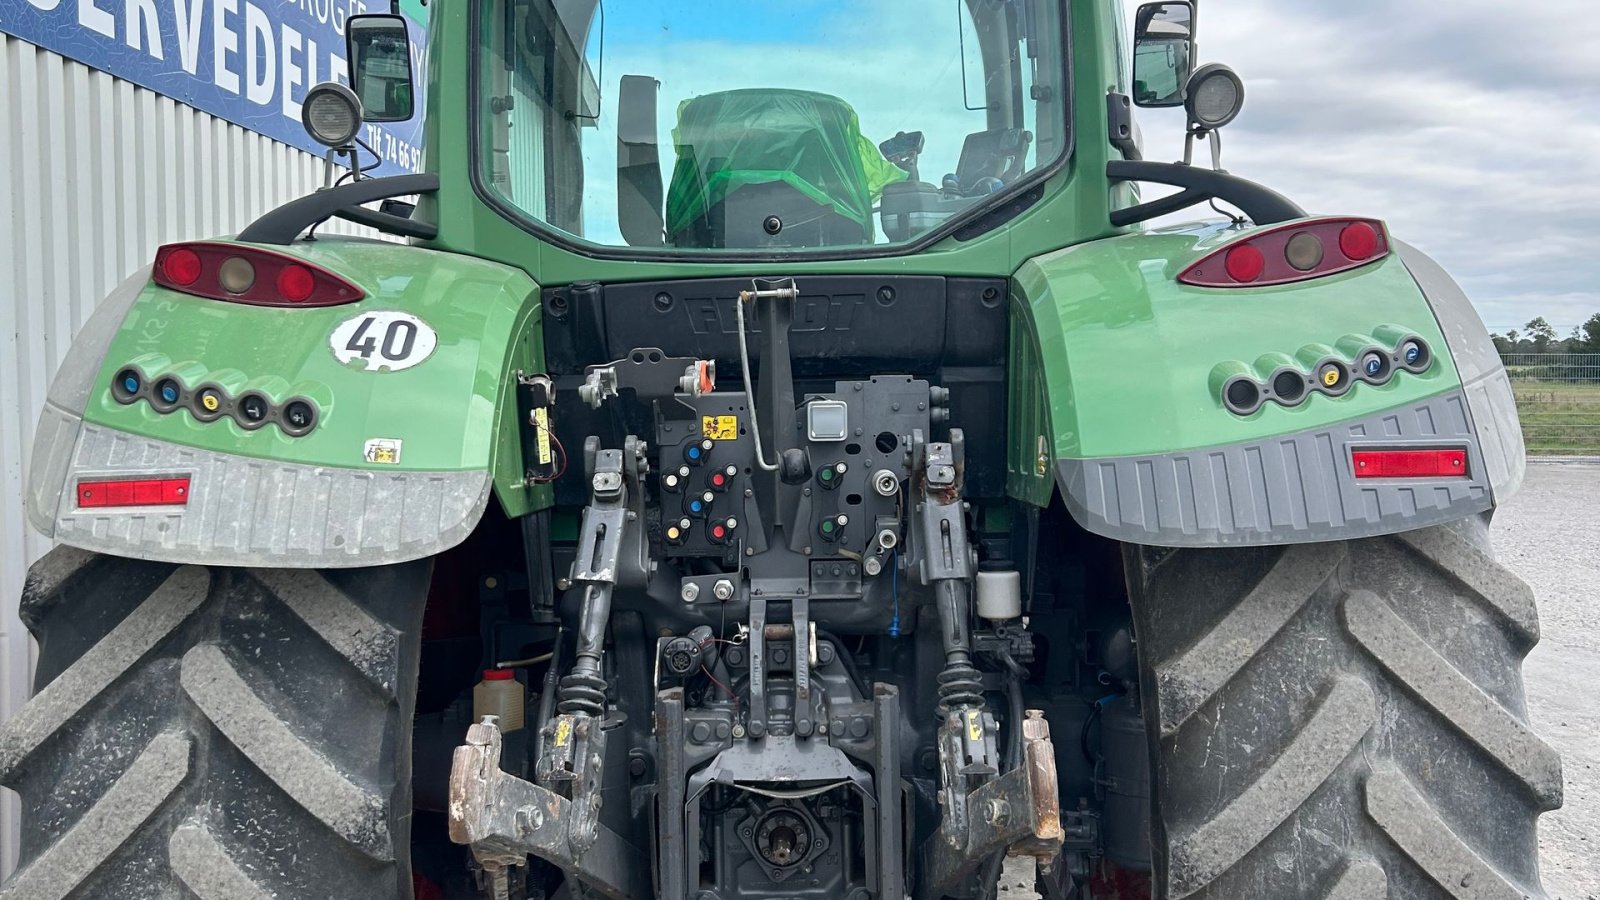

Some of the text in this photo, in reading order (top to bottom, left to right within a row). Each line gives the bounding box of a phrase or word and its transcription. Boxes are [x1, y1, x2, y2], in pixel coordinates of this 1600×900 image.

[385, 133, 397, 164] 74
[398, 140, 410, 170] 66
[684, 293, 866, 334] FEDT
[345, 317, 418, 361] 40
